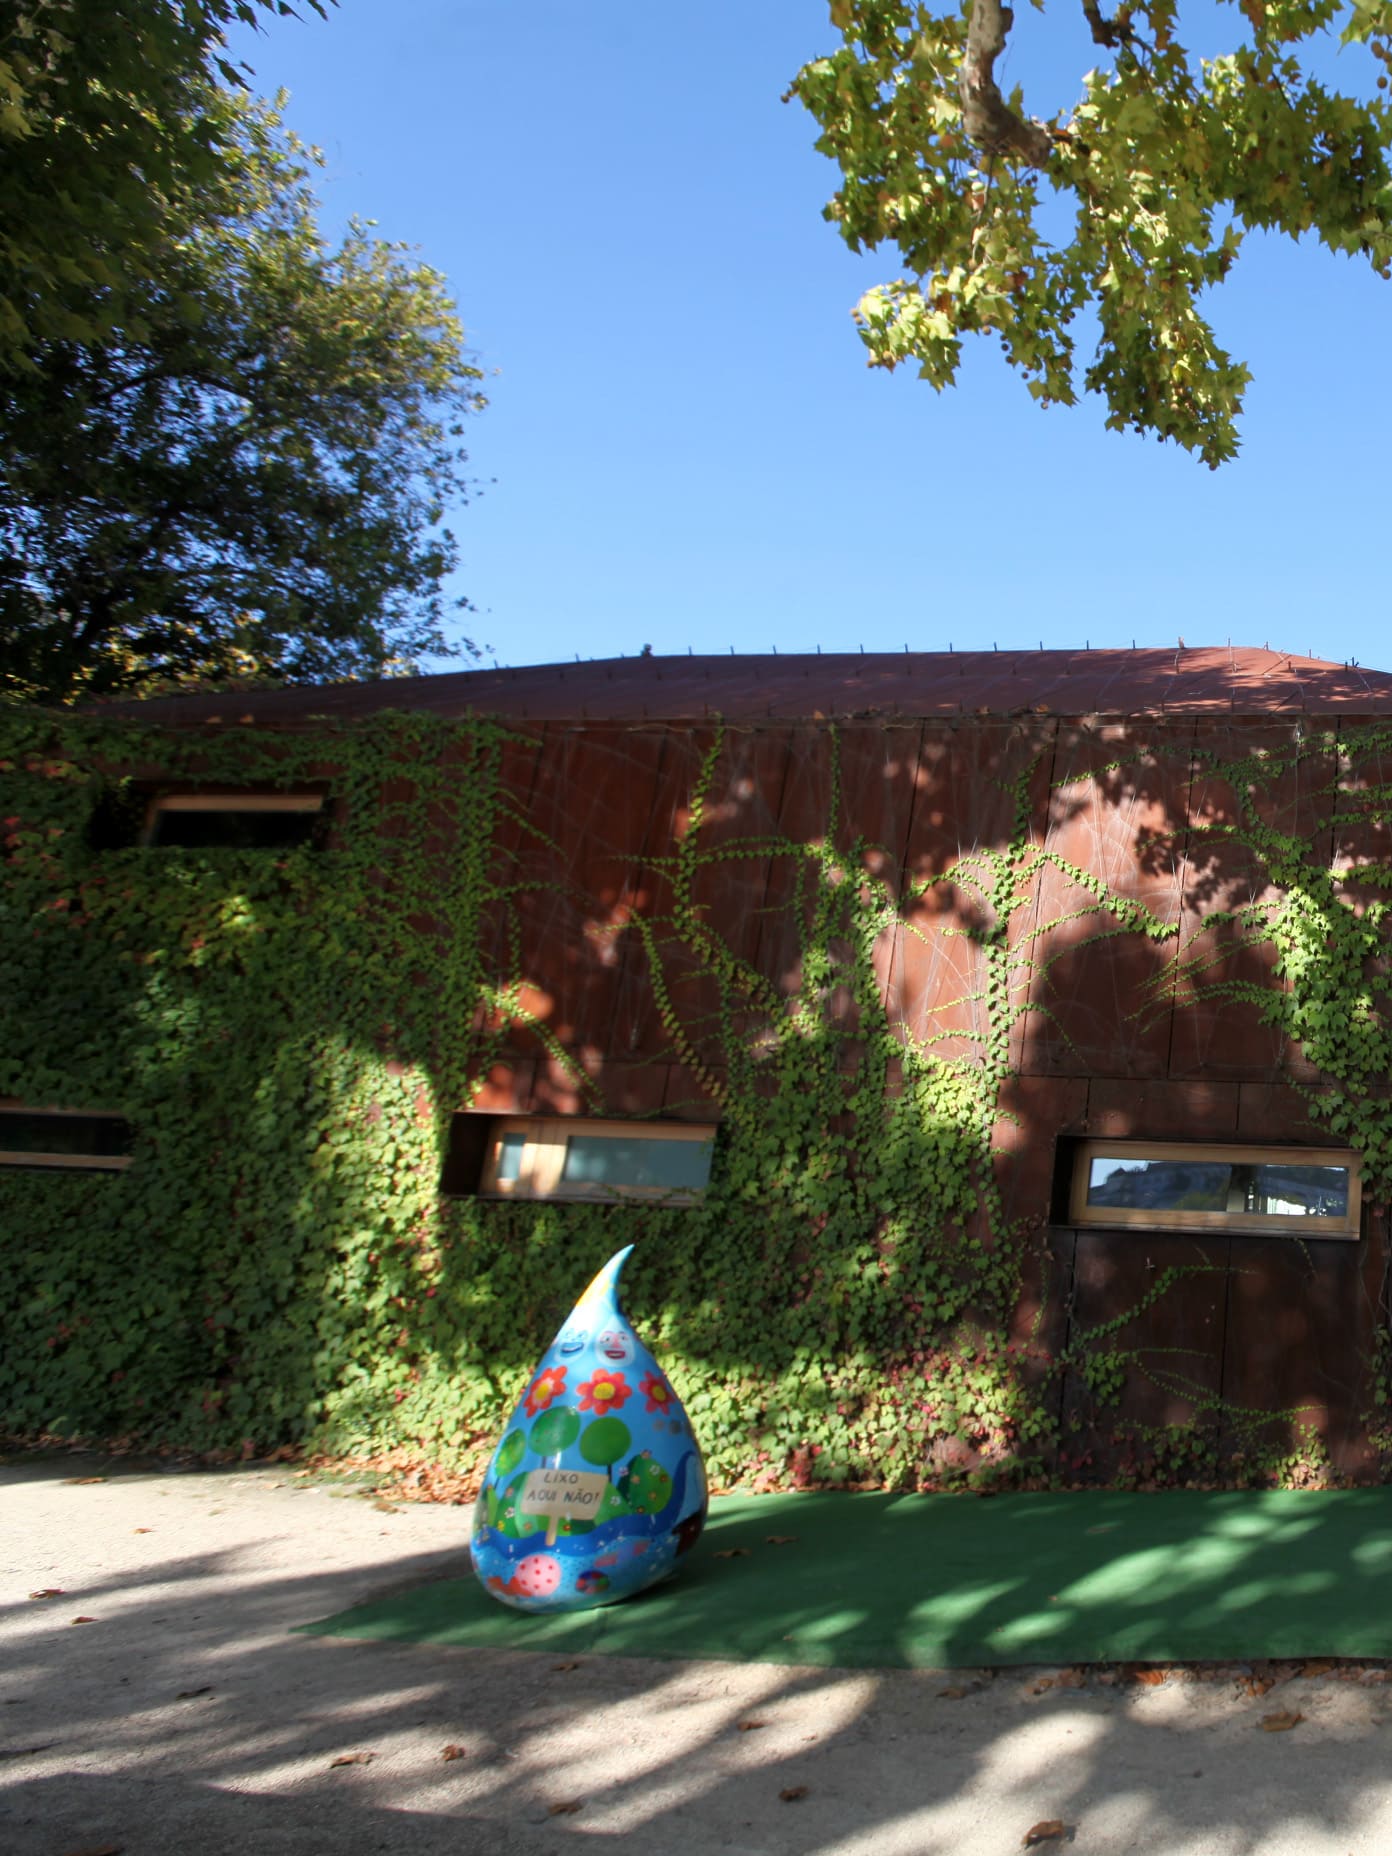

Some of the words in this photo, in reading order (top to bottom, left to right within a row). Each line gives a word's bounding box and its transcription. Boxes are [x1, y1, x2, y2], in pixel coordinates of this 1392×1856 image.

[544, 1471, 579, 1484] LIXO
[527, 1489, 557, 1502] AQUI
[563, 1488, 600, 1505] NÃO!
